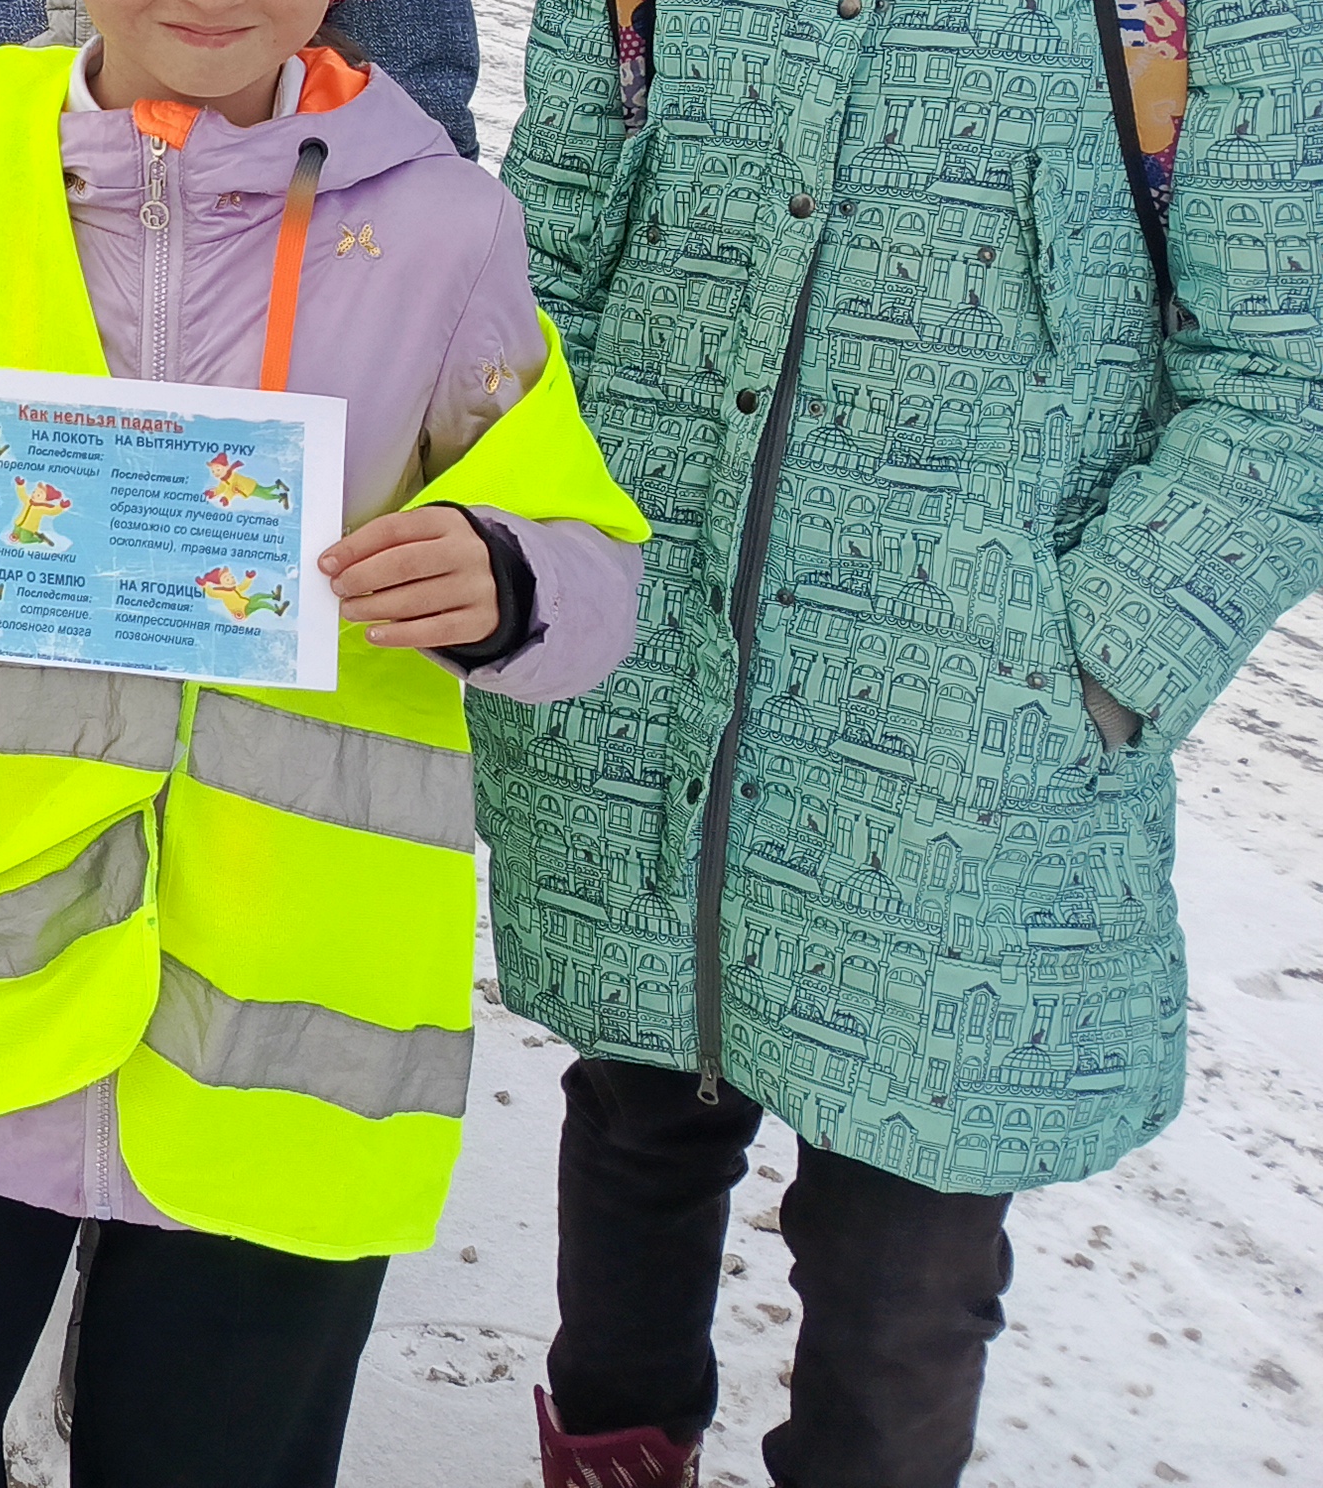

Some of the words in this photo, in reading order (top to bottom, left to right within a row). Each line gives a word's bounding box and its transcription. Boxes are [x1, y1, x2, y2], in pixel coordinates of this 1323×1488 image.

[18, 404, 49, 423] Как
[53, 409, 117, 429] нельзя
[121, 416, 184, 435] падать
[31, 429, 49, 442] НА
[52, 431, 104, 446] ЛОКОТЬ
[114, 434, 133, 447] НА
[136, 436, 219, 453] ВЫТЯНУТУЮ
[223, 442, 256, 457] РУКУ
[27, 445, 104, 461] Последствия:
[48, 463, 100, 478] ключицы
[110, 468, 189, 484] Последствия:
[110, 486, 161, 500] перелом
[109, 502, 183, 519] образующих
[185, 508, 233, 523] лучевой
[236, 513, 279, 528] сустав
[173, 525, 187, 535] со
[190, 526, 260, 542] смещением
[263, 533, 285, 545] или
[27, 550, 77, 564] чашечки
[181, 542, 228, 557] травма
[26, 570, 36, 583] О
[39, 572, 86, 588] ЗЕМЛЮ
[16, 586, 93, 603] Последствия:
[119, 579, 138, 593] НА
[140, 581, 206, 599] ЯГОДИЦЫ
[115, 595, 194, 613] Последствия:
[57, 625, 92, 638] мозга
[115, 612, 211, 631] компрессионная
[214, 622, 262, 637] травма
